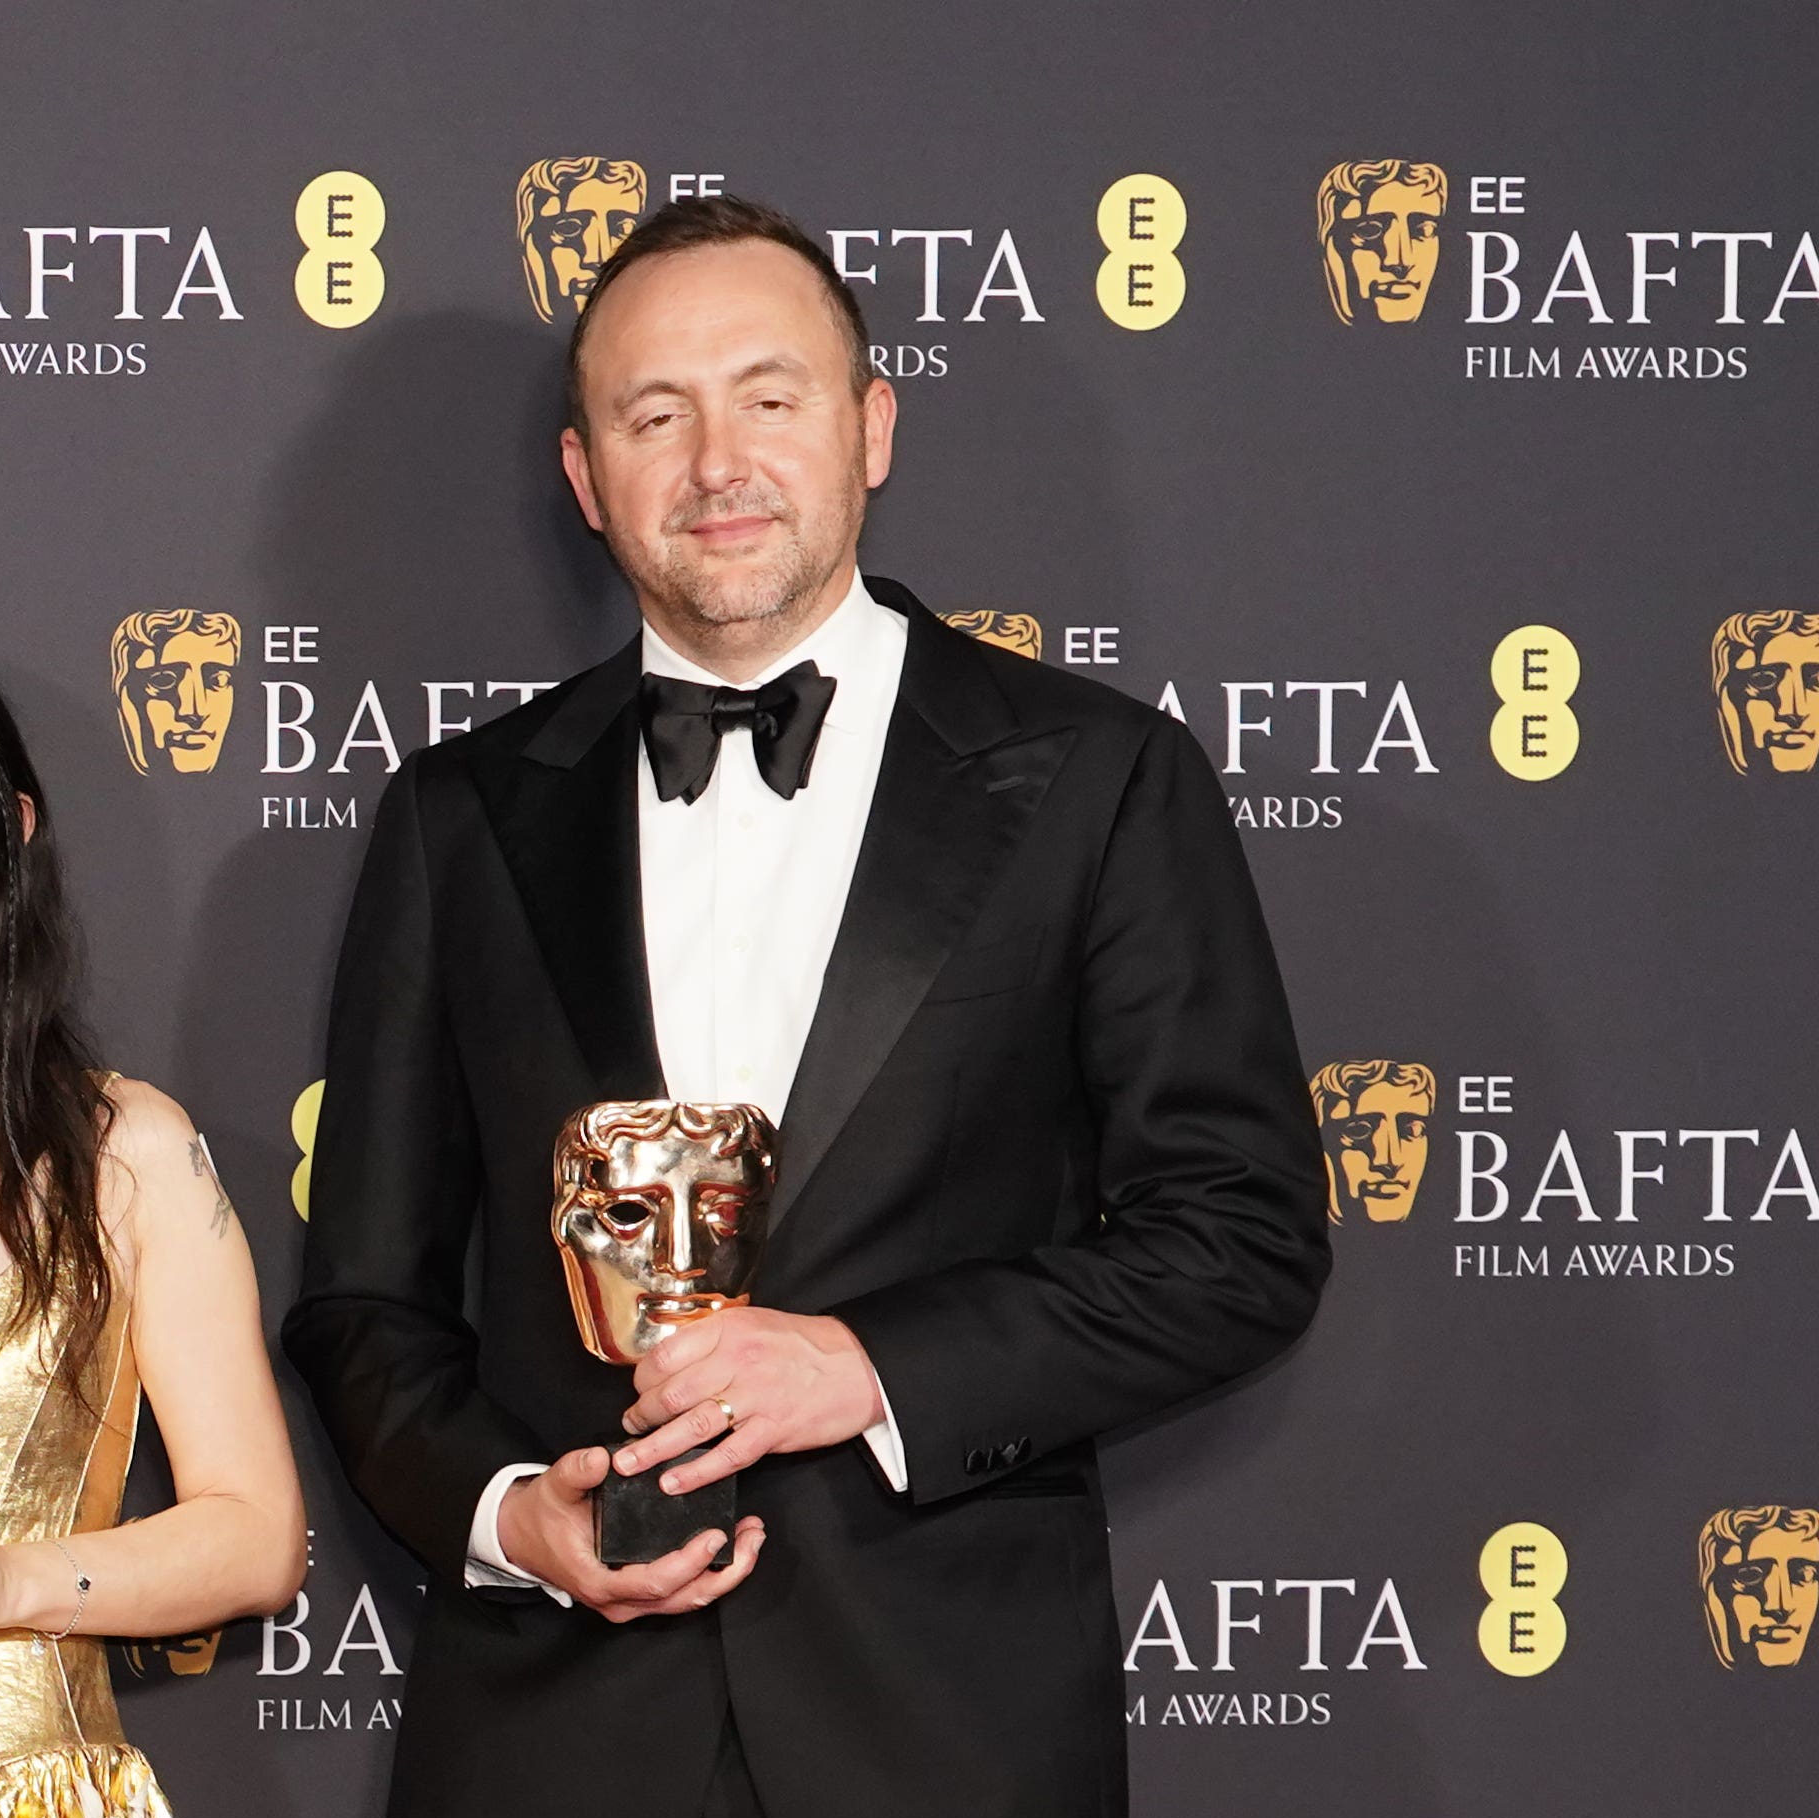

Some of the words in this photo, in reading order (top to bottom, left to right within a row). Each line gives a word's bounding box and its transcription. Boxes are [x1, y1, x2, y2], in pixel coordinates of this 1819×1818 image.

[1471, 177, 1525, 213] EE
[1465, 231, 1819, 323] BAFTA
[1466, 347, 1560, 378] FILM
[1576, 347, 1747, 378] AWARDS
[265, 627, 319, 662] EE
[1065, 627, 1119, 663] EE
[262, 797, 356, 828] FILM
[1229, 797, 1342, 828] ARDS
[1459, 1077, 1513, 1112] EE
[1454, 1129, 1819, 1222] BAFTA
[1456, 1246, 1548, 1276] FILM
[1564, 1244, 1734, 1276] AWARDS
[259, 1700, 351, 1729] FILM
[1161, 1693, 1330, 1725] AWARDS
